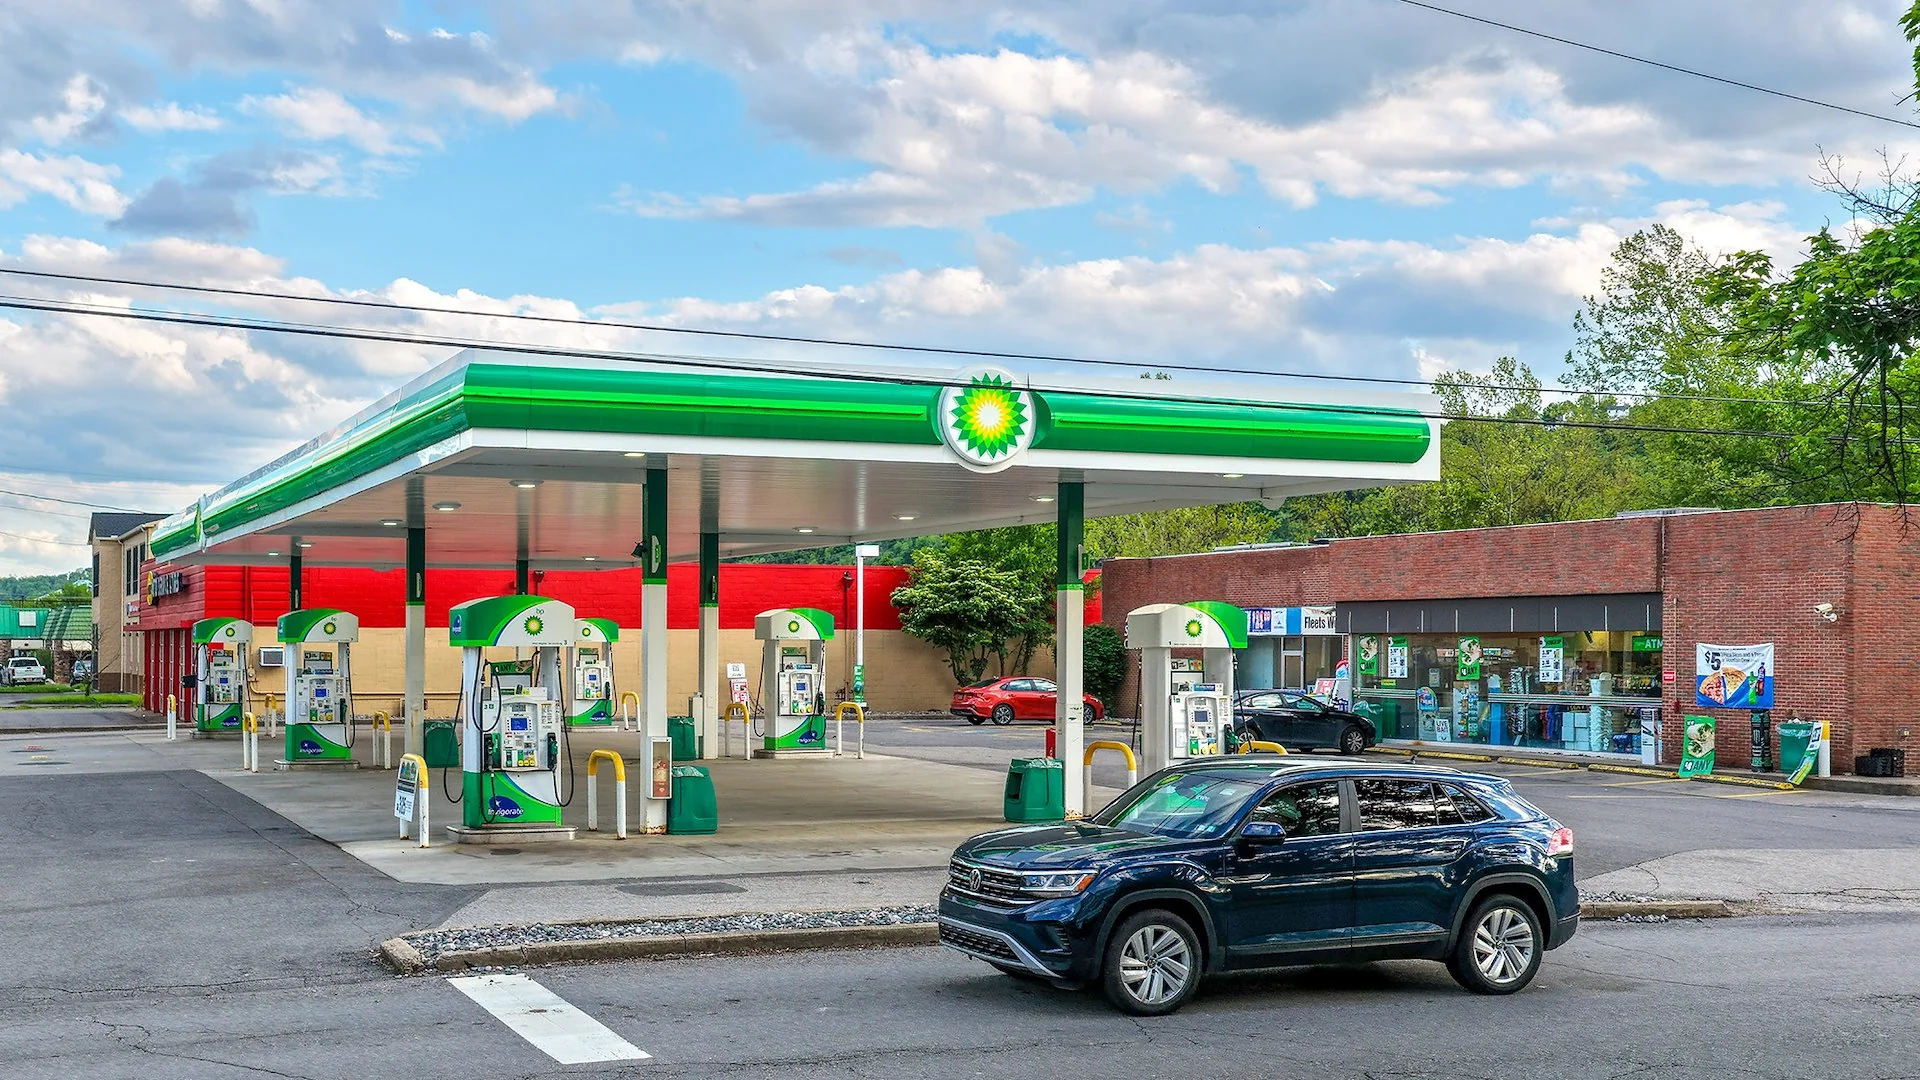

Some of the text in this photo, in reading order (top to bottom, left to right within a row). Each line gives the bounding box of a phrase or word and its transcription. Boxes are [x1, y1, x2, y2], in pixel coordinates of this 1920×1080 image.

[1304, 616, 1326, 629] Fleets
[1704, 651, 1721, 671] $5
[1693, 760, 1710, 770] ANY
